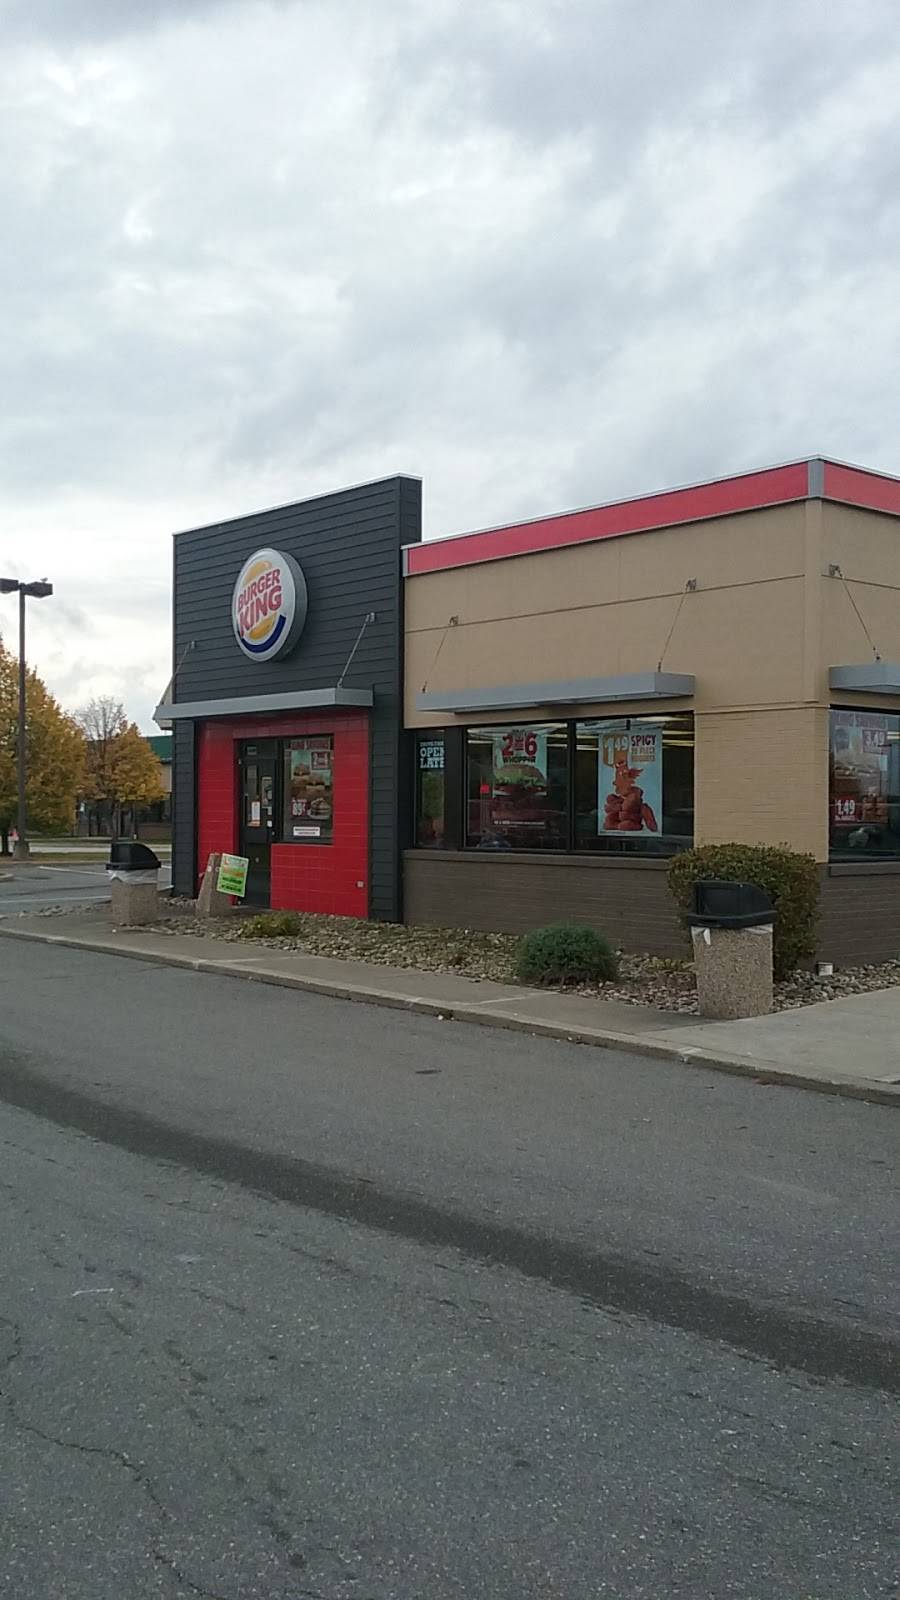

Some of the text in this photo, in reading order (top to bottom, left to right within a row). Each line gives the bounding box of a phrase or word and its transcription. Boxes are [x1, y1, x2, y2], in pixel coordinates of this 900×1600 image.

[238, 568, 281, 613] BURGER
[239, 585, 282, 637] KING
[501, 734, 513, 756] 2
[525, 732, 538, 756] 6
[631, 735, 656, 746] SPICY
